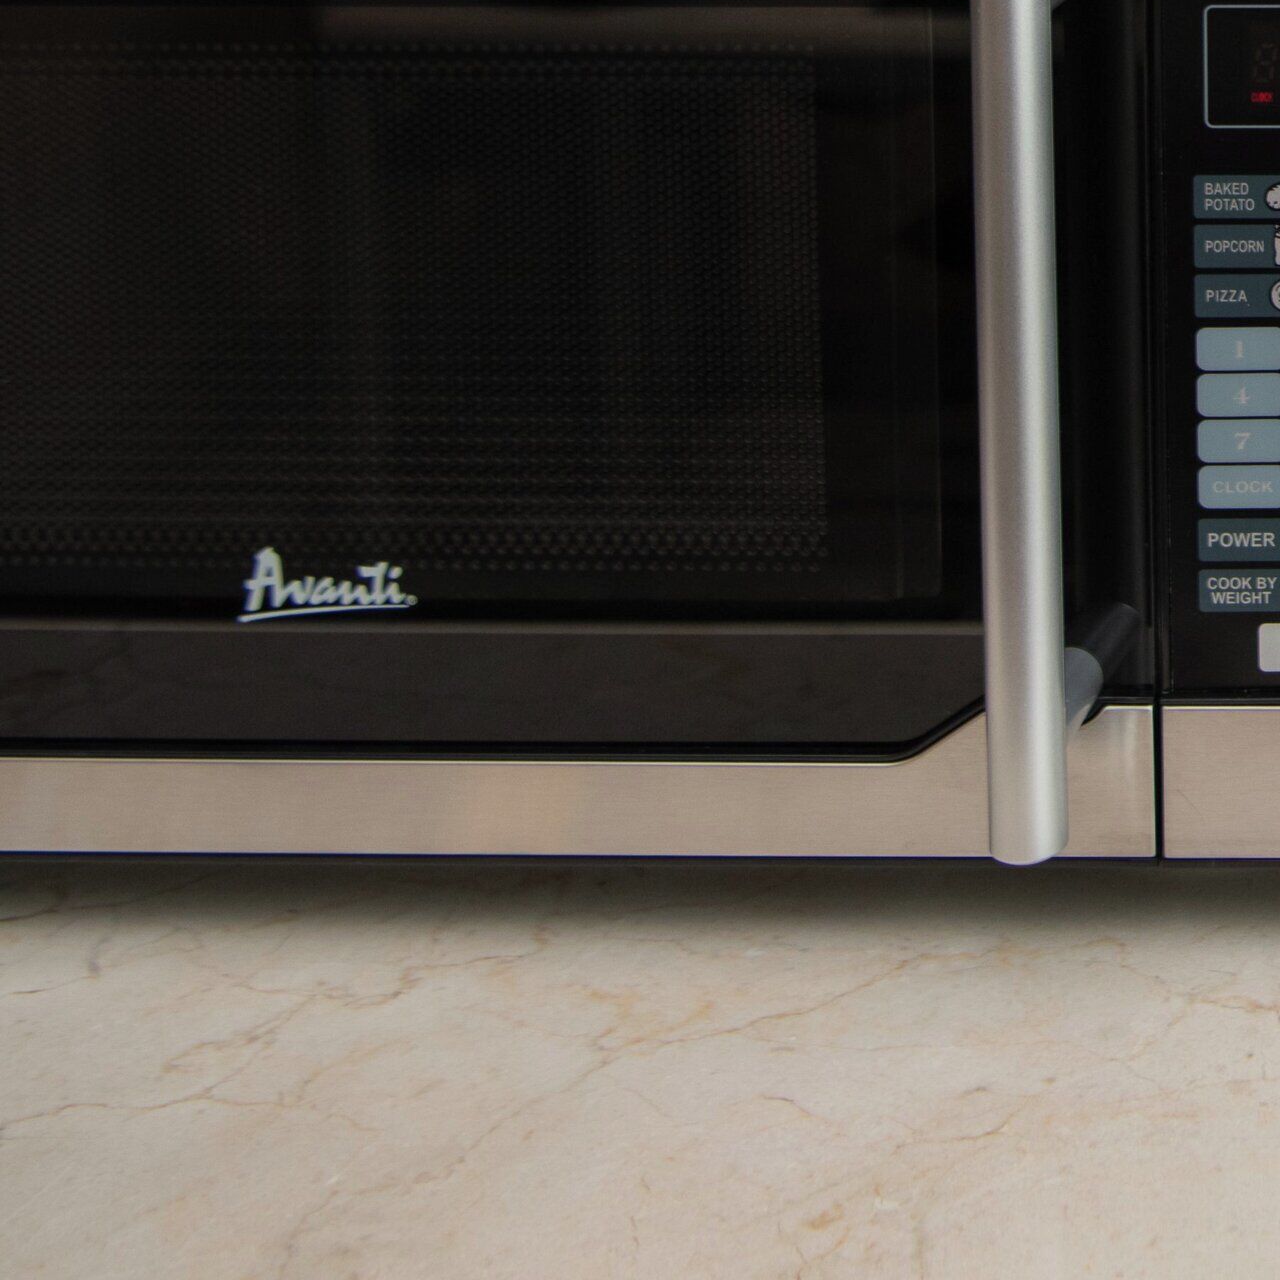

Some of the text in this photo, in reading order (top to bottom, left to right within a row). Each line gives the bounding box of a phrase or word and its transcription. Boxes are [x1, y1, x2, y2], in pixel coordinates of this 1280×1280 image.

[1204, 183, 1249, 196] BAKED
[1204, 199, 1255, 211] POTATO
[1205, 240, 1265, 253] POPCORN
[1206, 290, 1247, 303] PIZZA
[1234, 339, 1245, 359] 1
[1232, 386, 1251, 405] 4
[1233, 432, 1251, 450] 7
[1212, 480, 1273, 494] CLOCK
[1207, 533, 1276, 548] POWER
[242, 546, 408, 612] Avanti
[1207, 577, 1278, 590] COOK BY
[1211, 591, 1271, 604] WEIGHT
